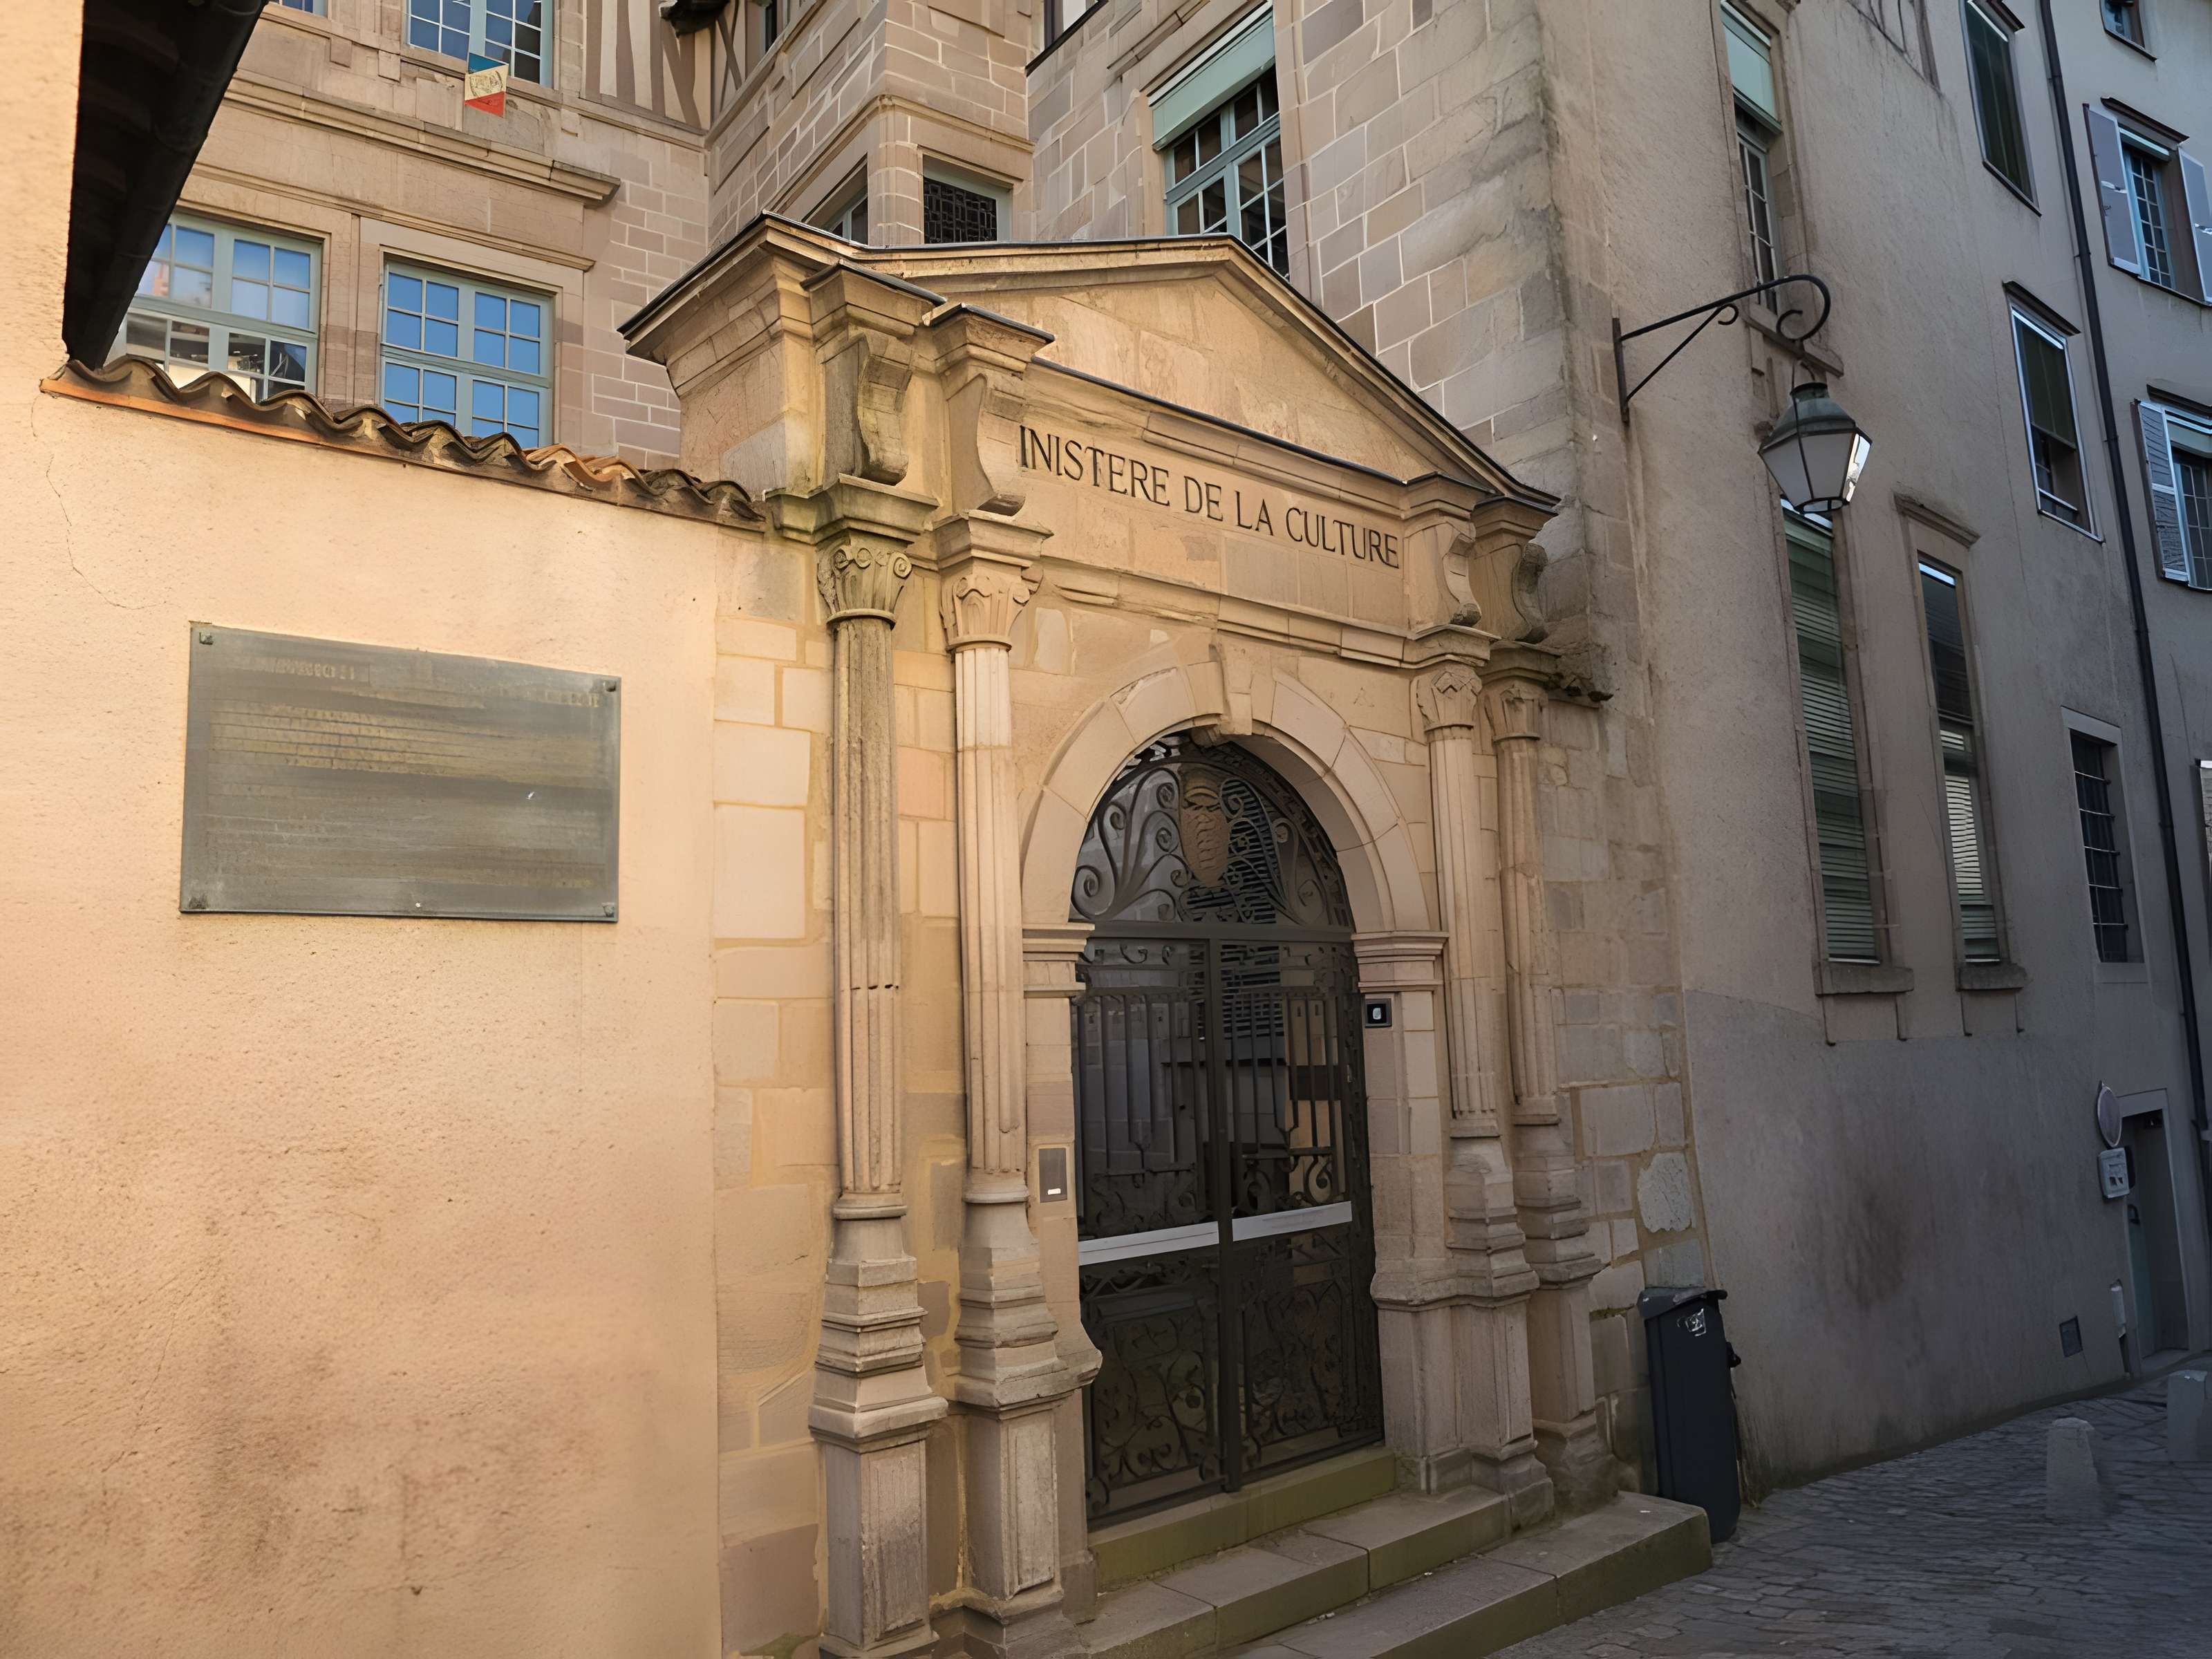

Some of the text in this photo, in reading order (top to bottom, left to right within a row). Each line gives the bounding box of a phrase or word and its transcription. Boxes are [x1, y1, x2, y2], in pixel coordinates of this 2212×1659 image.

[1184, 475, 1224, 522] DE
[1235, 490, 1274, 536] LA
[1285, 507, 1400, 568] CULTURE
